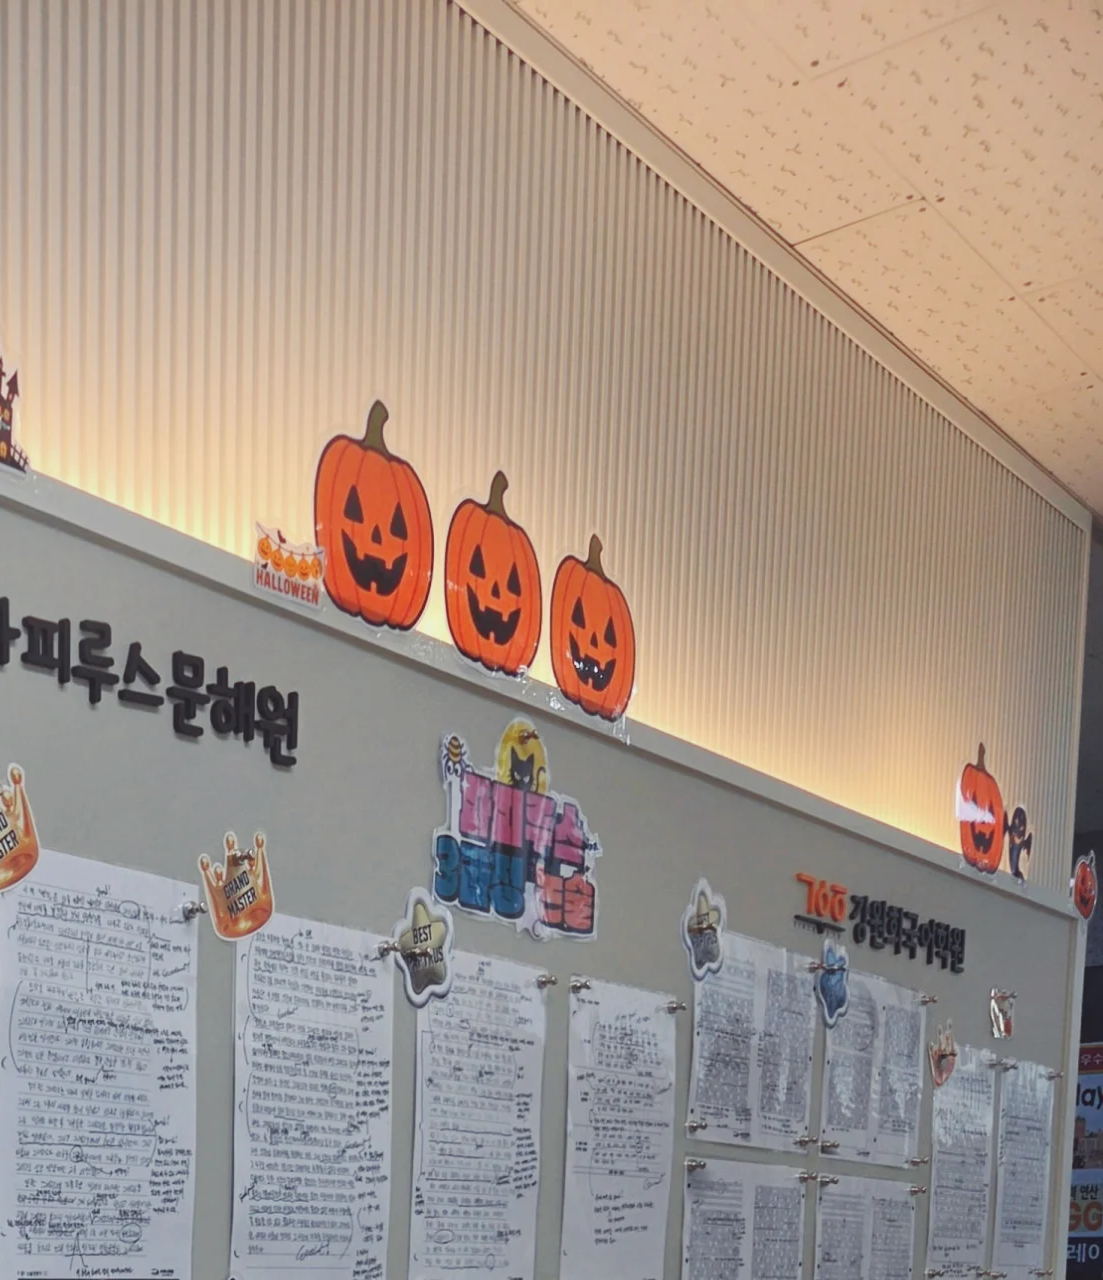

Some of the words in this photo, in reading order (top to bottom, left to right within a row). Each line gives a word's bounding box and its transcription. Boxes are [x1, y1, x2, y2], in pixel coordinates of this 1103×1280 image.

[256, 567, 319, 605] HALLOWEEN
[459, 770, 585, 865] 파피루스
[223, 871, 250, 899] GRAND
[227, 887, 258, 919] MASTER
[412, 924, 433, 945] BEST
